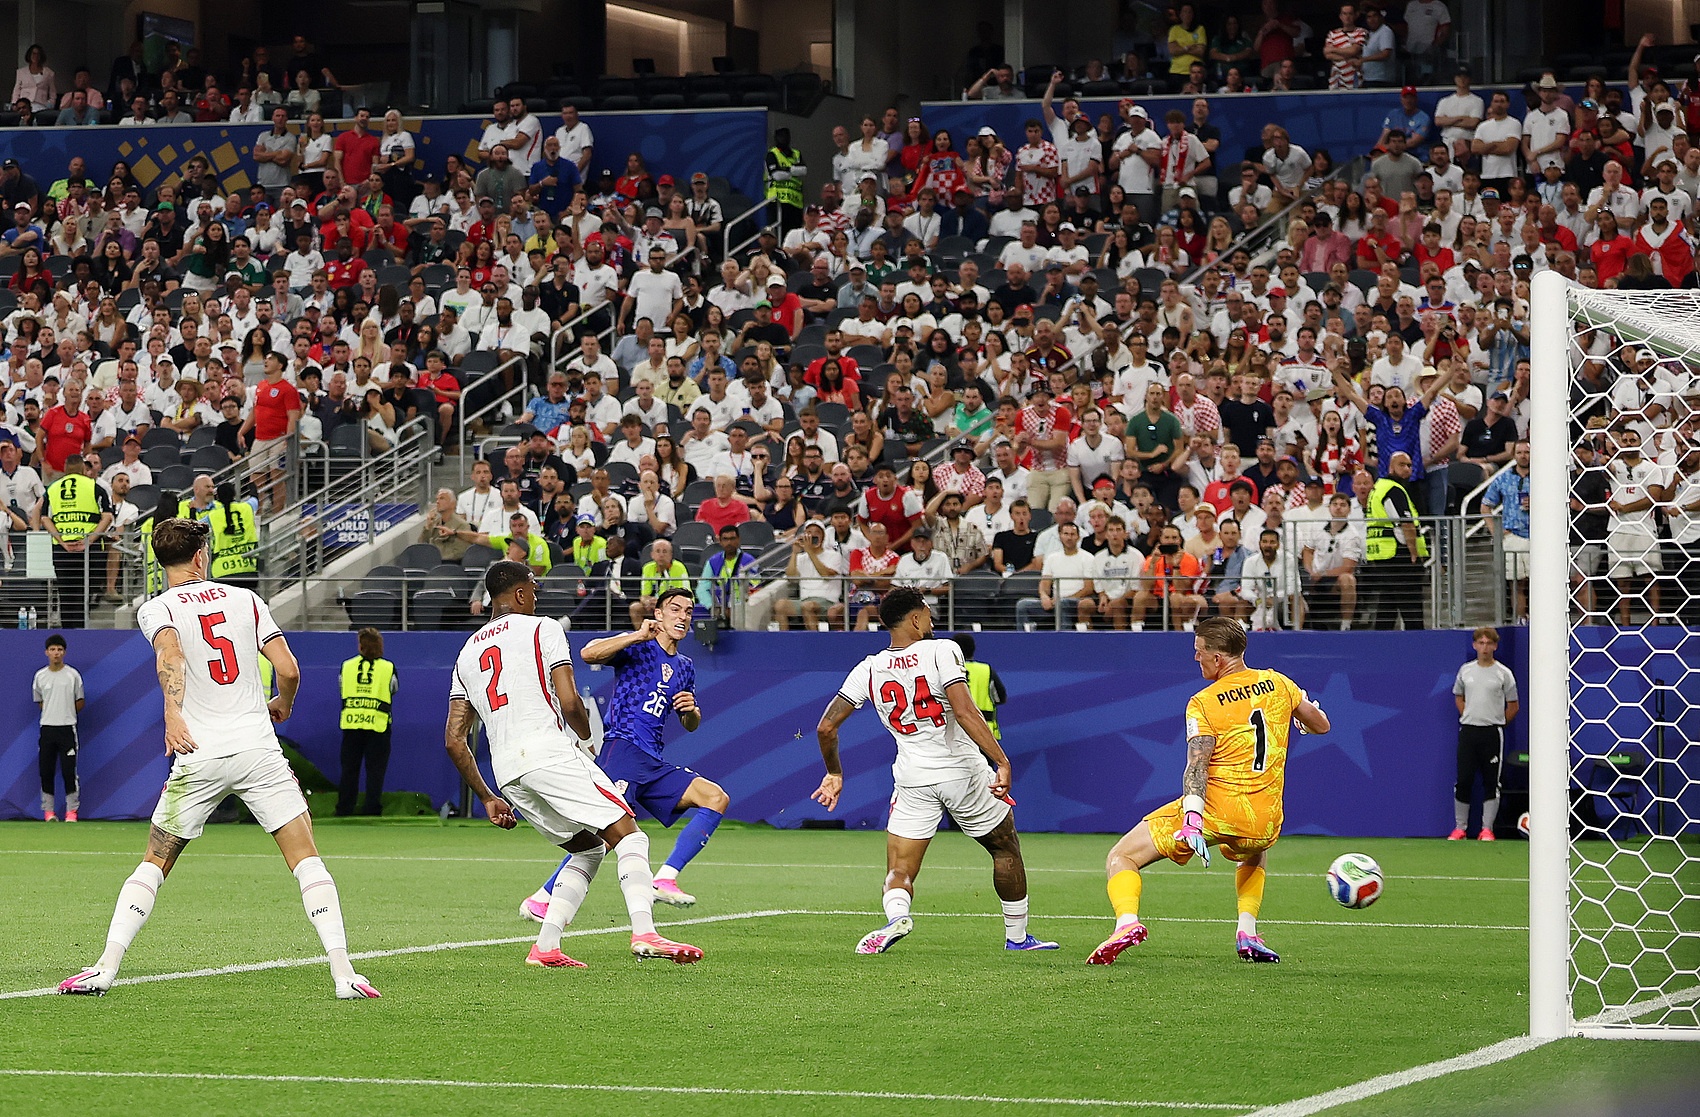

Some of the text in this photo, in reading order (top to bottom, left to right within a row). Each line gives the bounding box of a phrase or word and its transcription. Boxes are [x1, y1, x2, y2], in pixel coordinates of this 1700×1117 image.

[473, 621, 509, 644] KONSA
[198, 611, 240, 685] 5
[479, 645, 508, 712] 2
[642, 691, 668, 718] 26
[880, 675, 946, 735] 24
[1216, 679, 1275, 706] PICKFORD
[1250, 708, 1267, 772] 1
[129, 904, 146, 917] ENG
[311, 906, 328, 918] ENG
